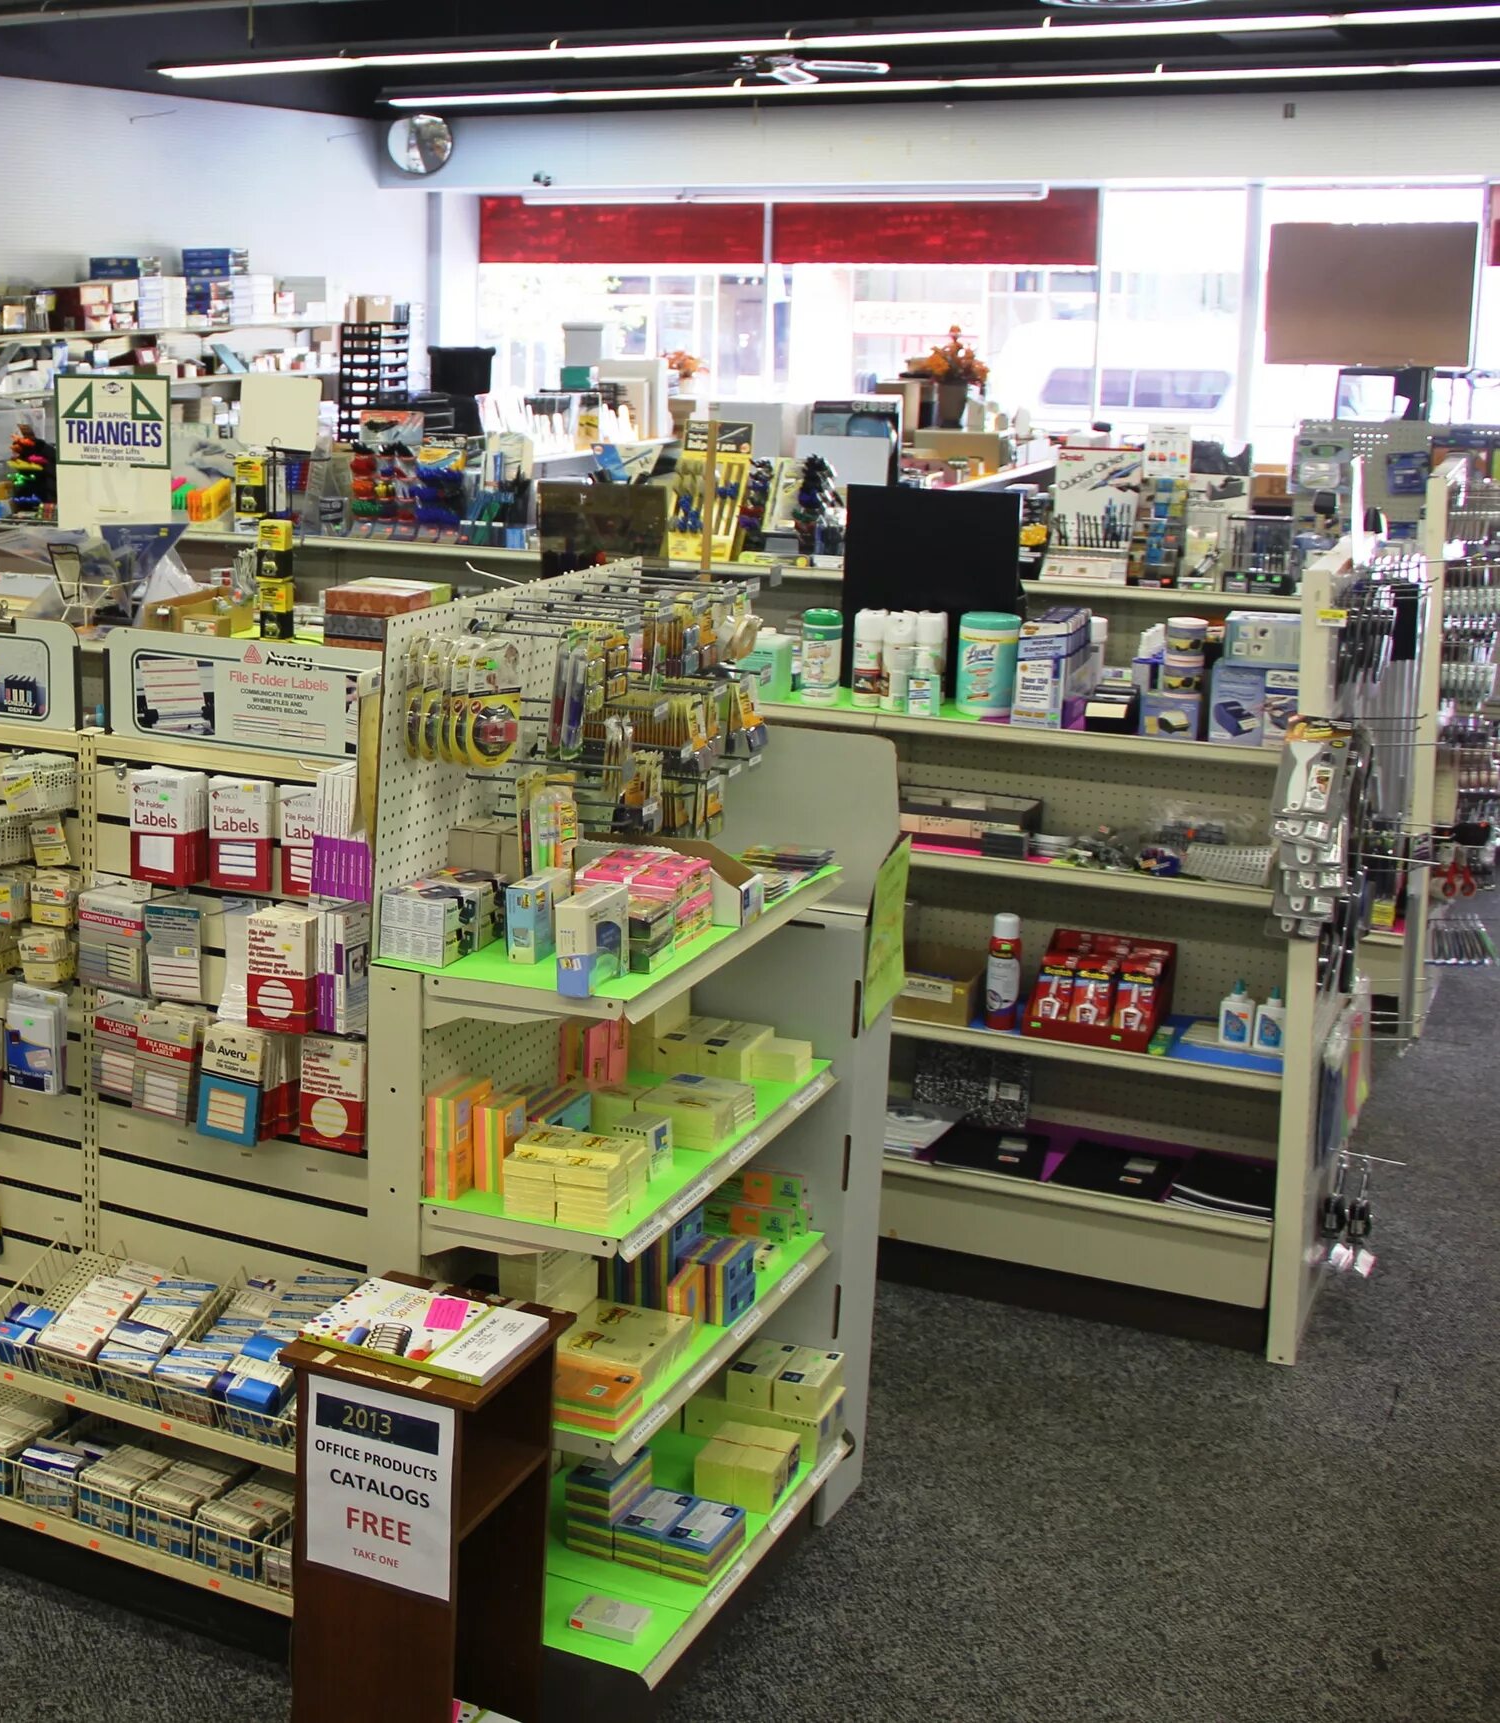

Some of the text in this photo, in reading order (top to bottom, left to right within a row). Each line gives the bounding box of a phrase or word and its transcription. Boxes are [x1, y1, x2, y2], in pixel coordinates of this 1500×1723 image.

[851, 401, 895, 412] GLOBE
[65, 420, 162, 447] TRIANGLES
[101, 447, 124, 456] Finger
[966, 644, 995, 660] Lysol
[265, 652, 314, 671] Avery
[229, 671, 329, 692] File Folder Labels
[240, 688, 282, 699] COMMUNICATE
[246, 704, 308, 716] DOCUMENTS BELONG
[252, 697, 273, 706] WHERE
[274, 699, 289, 707] FILES
[134, 799, 164, 809] File Folder
[213, 805, 245, 815] File Folder
[134, 810, 178, 829] Labels
[213, 816, 259, 833] Labels
[285, 813, 316, 822] File Folde
[82, 912, 113, 925] COMPUTER
[113, 919, 136, 929] LABELS
[1043, 966, 1073, 977] Scotch
[103, 1020, 136, 1032] FILE FOLDER
[108, 1027, 130, 1036] LABELS
[145, 1040, 181, 1053] FILE FOLDER
[151, 1047, 174, 1057] LABELS
[217, 1045, 248, 1062] Avery
[390, 1294, 429, 1319] Savings
[342, 1405, 392, 1435] 2013
[315, 1439, 438, 1482] OFFICE PRODUCTS
[330, 1468, 430, 1509] CATALOGS
[347, 1506, 412, 1546] FREE
[352, 1547, 400, 1569] TAKE ONE
